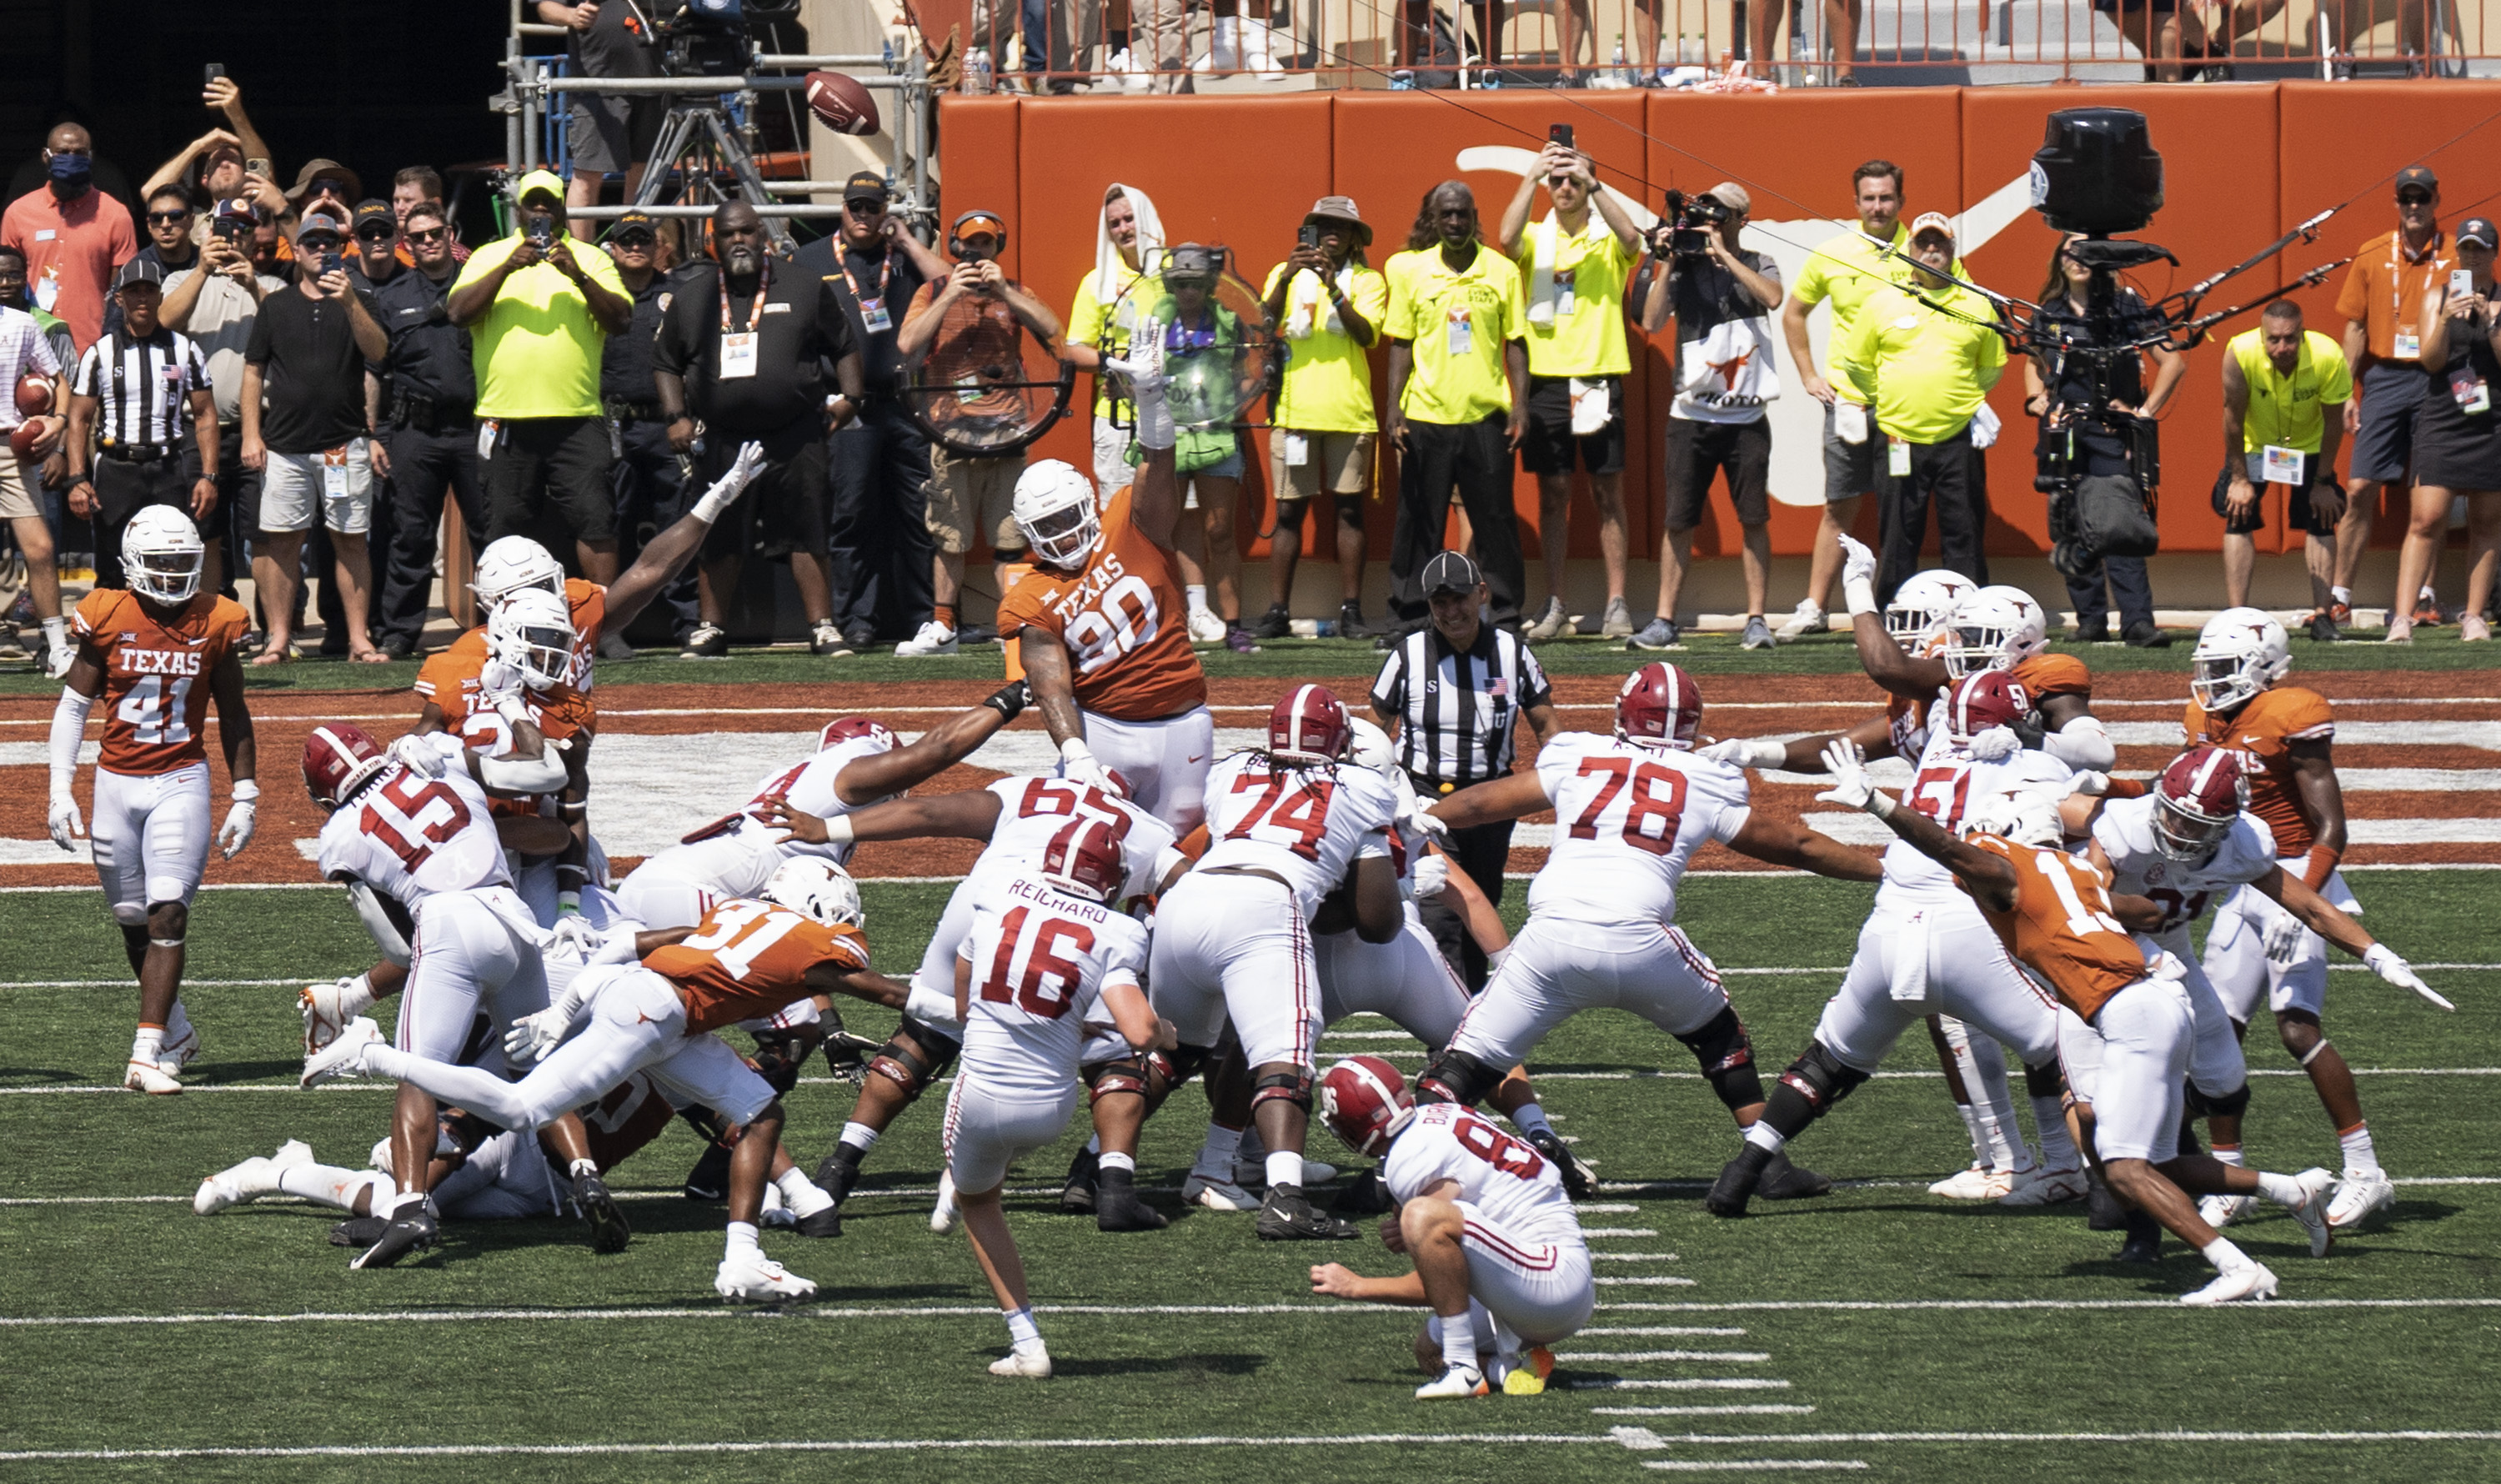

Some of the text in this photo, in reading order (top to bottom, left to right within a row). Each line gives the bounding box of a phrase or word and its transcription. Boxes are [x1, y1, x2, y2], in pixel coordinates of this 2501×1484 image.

[1052, 552, 1125, 625] TEXAS
[1064, 575, 1159, 674] 90
[120, 648, 202, 675] TEXAS
[565, 643, 593, 687] XAS
[118, 675, 193, 744] 41
[1494, 712, 1506, 729] U
[2007, 684, 2029, 710] 51
[358, 760, 473, 876] 15
[1019, 777, 1134, 841] 65
[1224, 773, 1335, 863] 74
[1568, 755, 1688, 856] 78
[1909, 766, 1972, 836] 51
[1009, 879, 1108, 925] REICHARD
[679, 899, 805, 981] 31
[980, 905, 1096, 1020] 16
